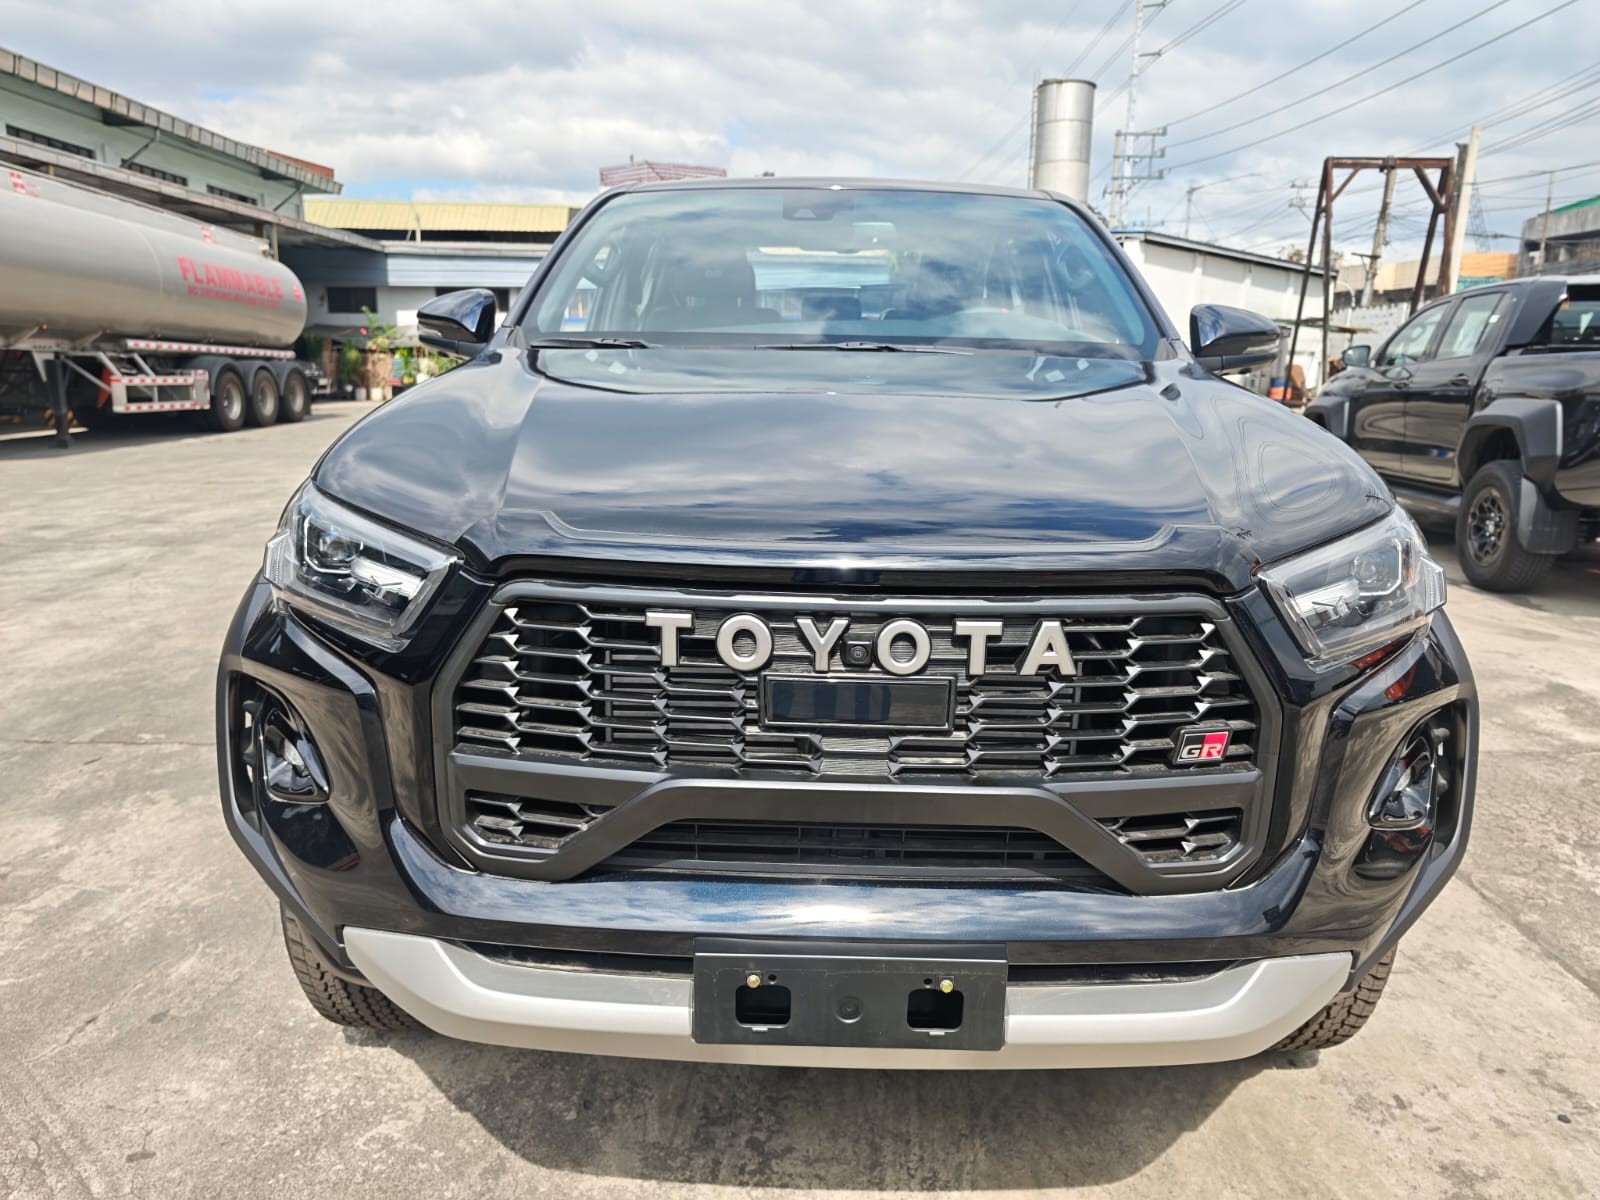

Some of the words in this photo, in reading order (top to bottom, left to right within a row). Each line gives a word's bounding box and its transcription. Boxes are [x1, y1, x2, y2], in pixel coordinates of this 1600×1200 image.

[176, 256, 284, 299] FLAMMABLE
[645, 611, 1077, 676] TOYOTA
[1181, 743, 1222, 759] GR
